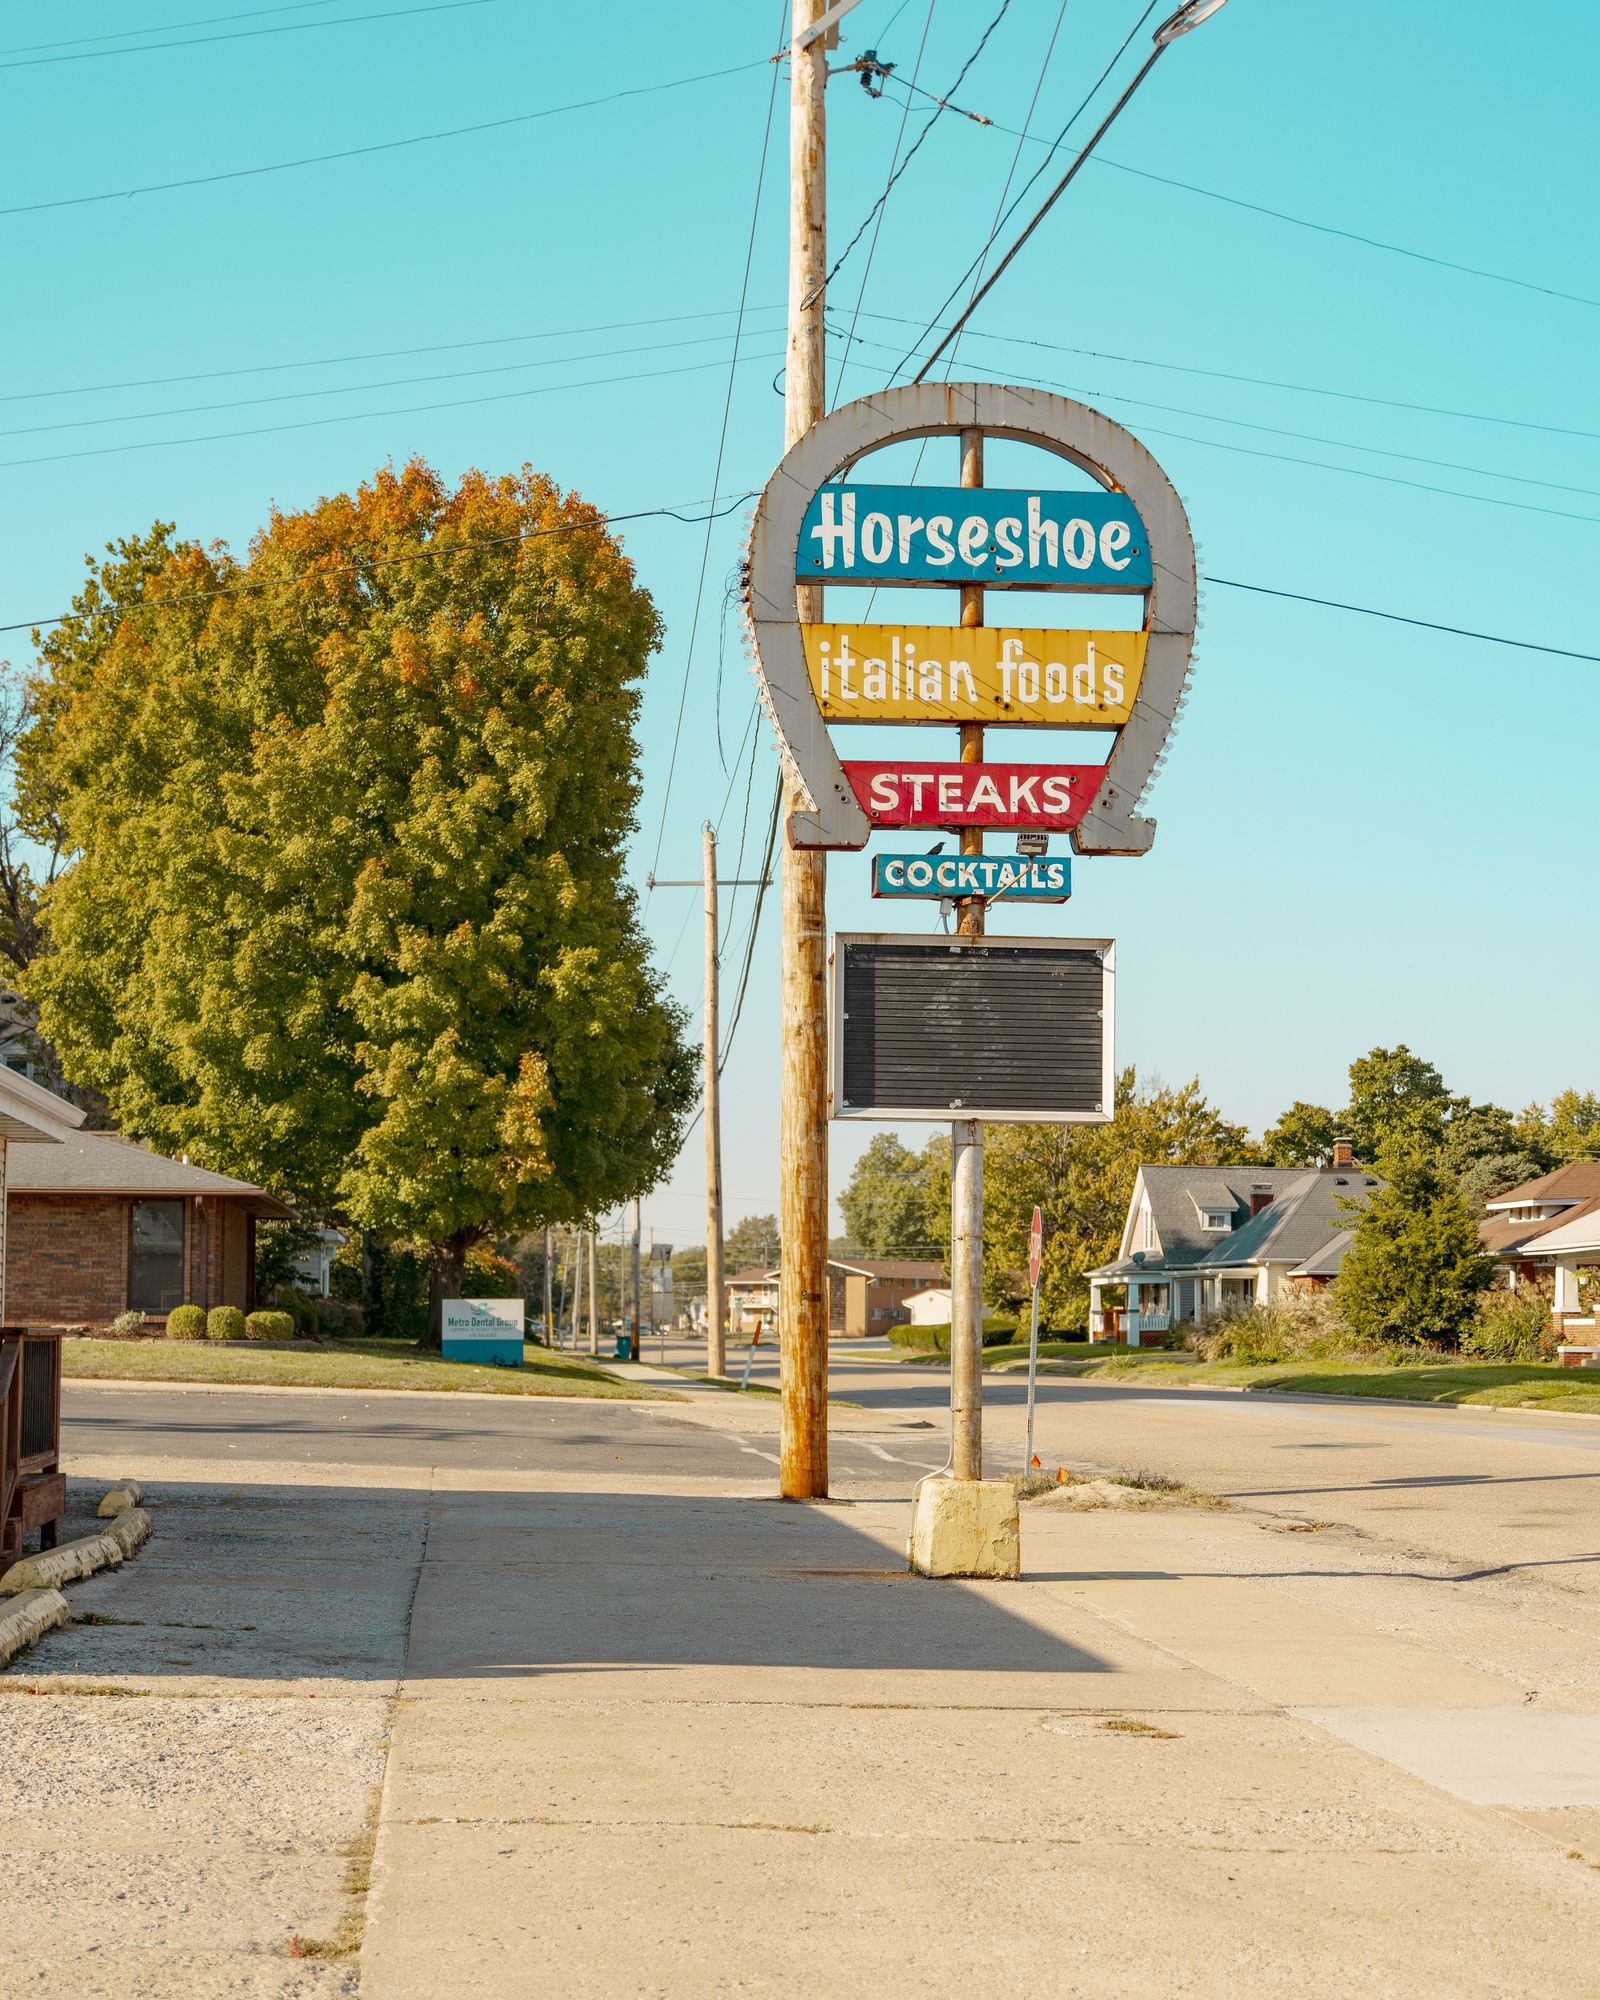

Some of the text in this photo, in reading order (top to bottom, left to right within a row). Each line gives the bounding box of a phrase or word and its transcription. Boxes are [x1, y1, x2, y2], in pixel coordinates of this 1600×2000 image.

[811, 491, 1131, 571] Horseshoe
[819, 634, 1124, 705] italian foods
[869, 773, 1071, 814] STEAKS
[884, 859, 1064, 889] COCKTAILS
[448, 1316, 518, 1328] Metro Dental Group
